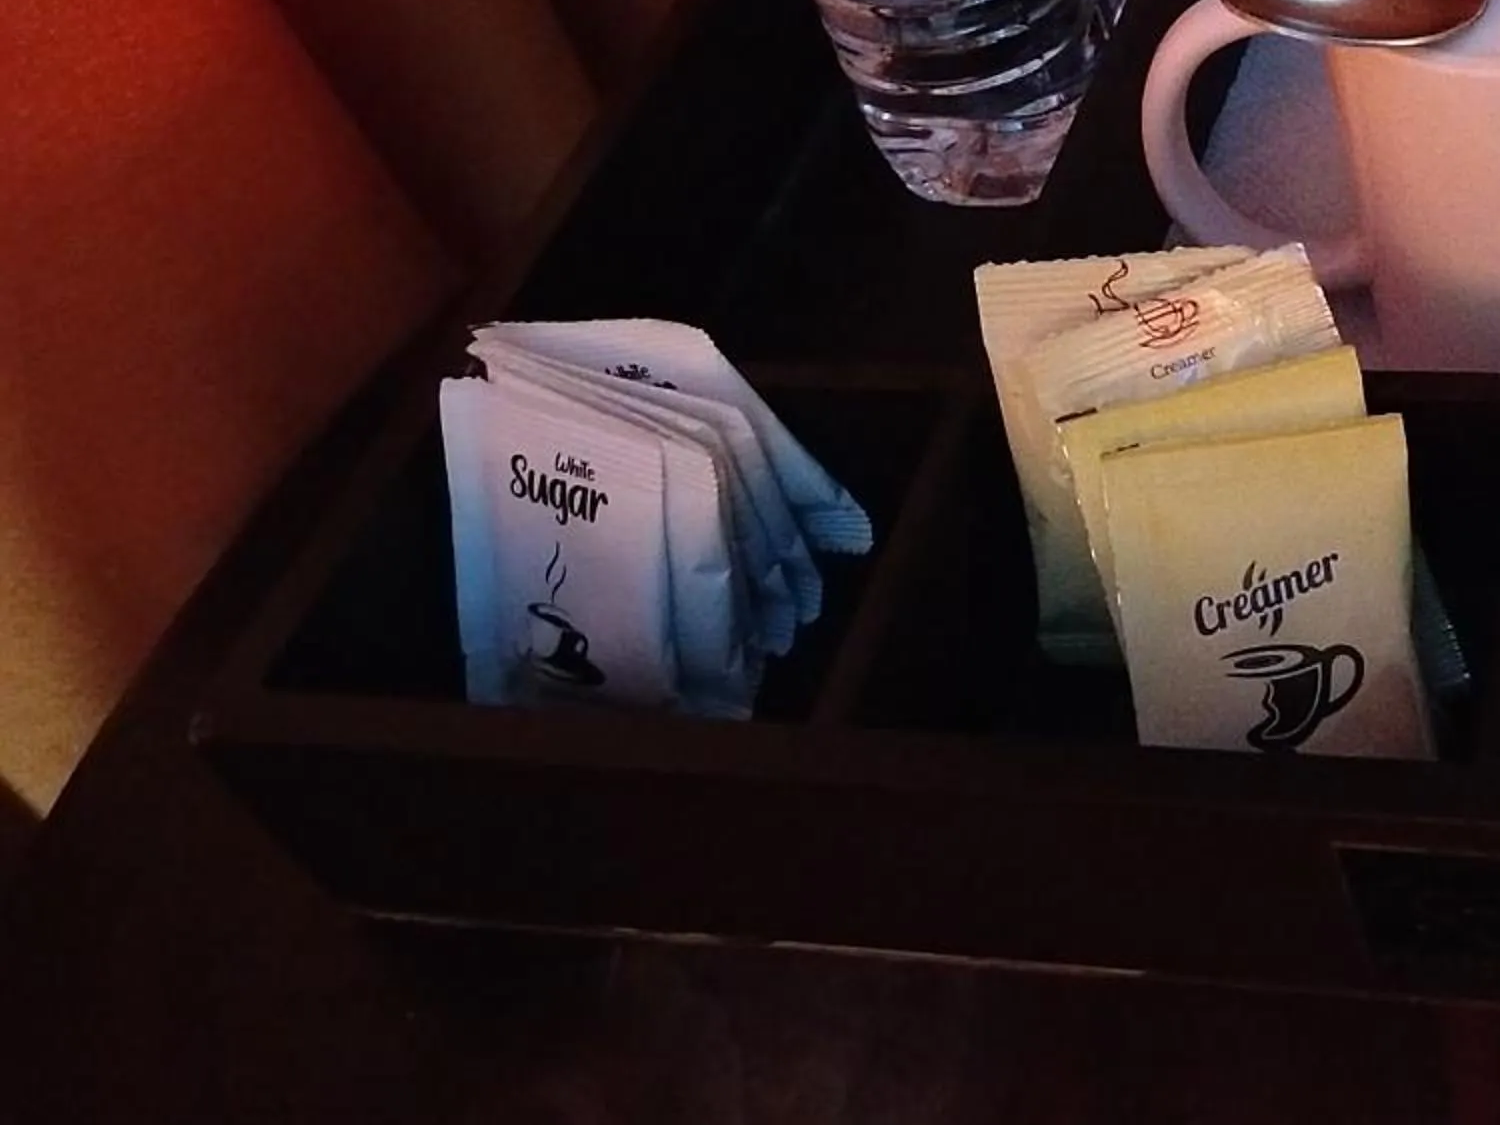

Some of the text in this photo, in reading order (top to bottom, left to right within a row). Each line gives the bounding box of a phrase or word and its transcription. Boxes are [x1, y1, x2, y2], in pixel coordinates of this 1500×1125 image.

[1150, 346, 1216, 380] Creamer
[510, 454, 608, 525] Sugar
[1195, 553, 1338, 635] Creamer
